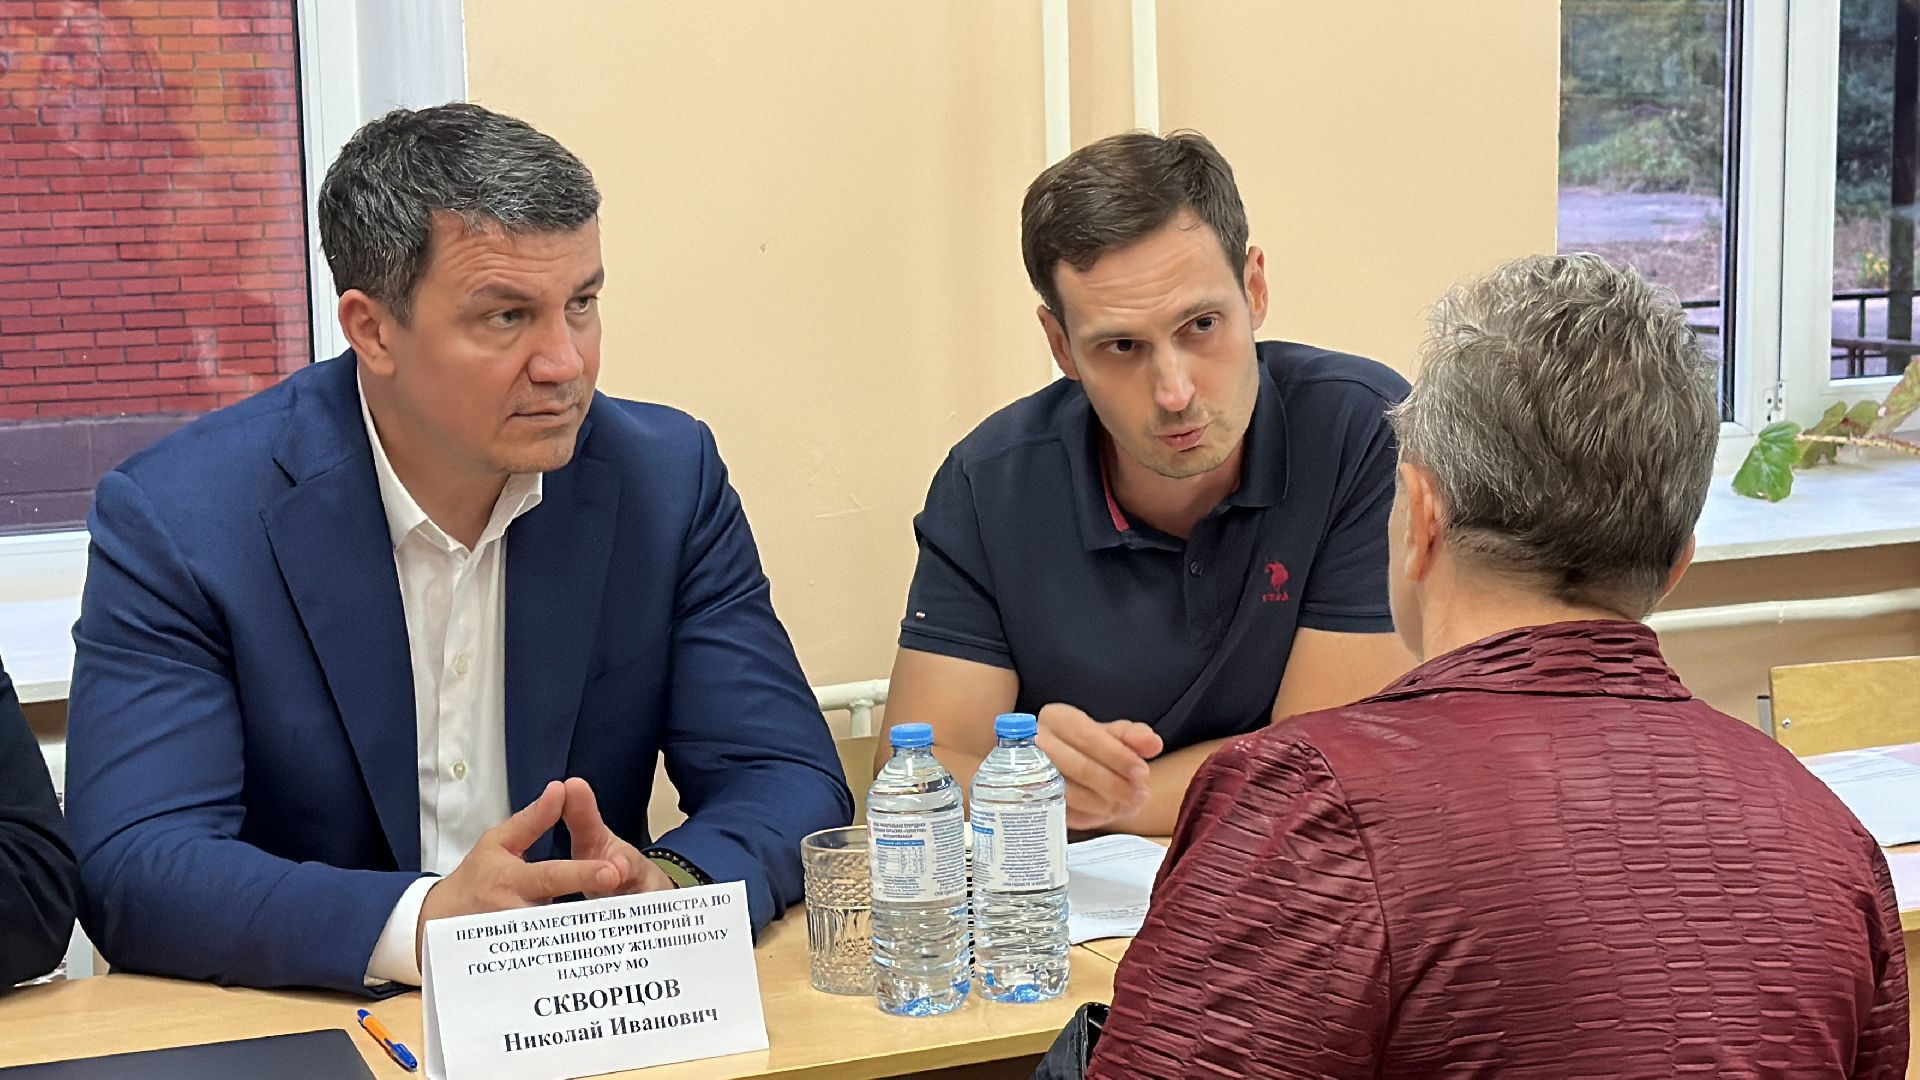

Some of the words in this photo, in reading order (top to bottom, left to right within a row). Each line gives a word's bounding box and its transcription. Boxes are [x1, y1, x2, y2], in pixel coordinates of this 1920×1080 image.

[456, 920, 518, 941] ПЕРВЫЙ
[521, 908, 626, 933] ЗАМЕСТИТЕЛЬ
[629, 898, 708, 917] МИНИСТРА
[711, 894, 731, 906] ПО
[489, 929, 596, 954] СОДЕРЖАНИЮ
[598, 916, 691, 939] ТЕРРИТОРИЙ
[695, 915, 704, 926] И
[468, 942, 626, 975] ГОСУДАРСТВЕННОМУ
[628, 929, 729, 952] ЖИЛИЩНОМУ
[558, 961, 623, 980] НАДЗОРУ
[626, 958, 649, 970] МО
[533, 978, 681, 1017] СКВОРЦОВ
[504, 1021, 603, 1052] Николай
[610, 1007, 718, 1035] Иванович
